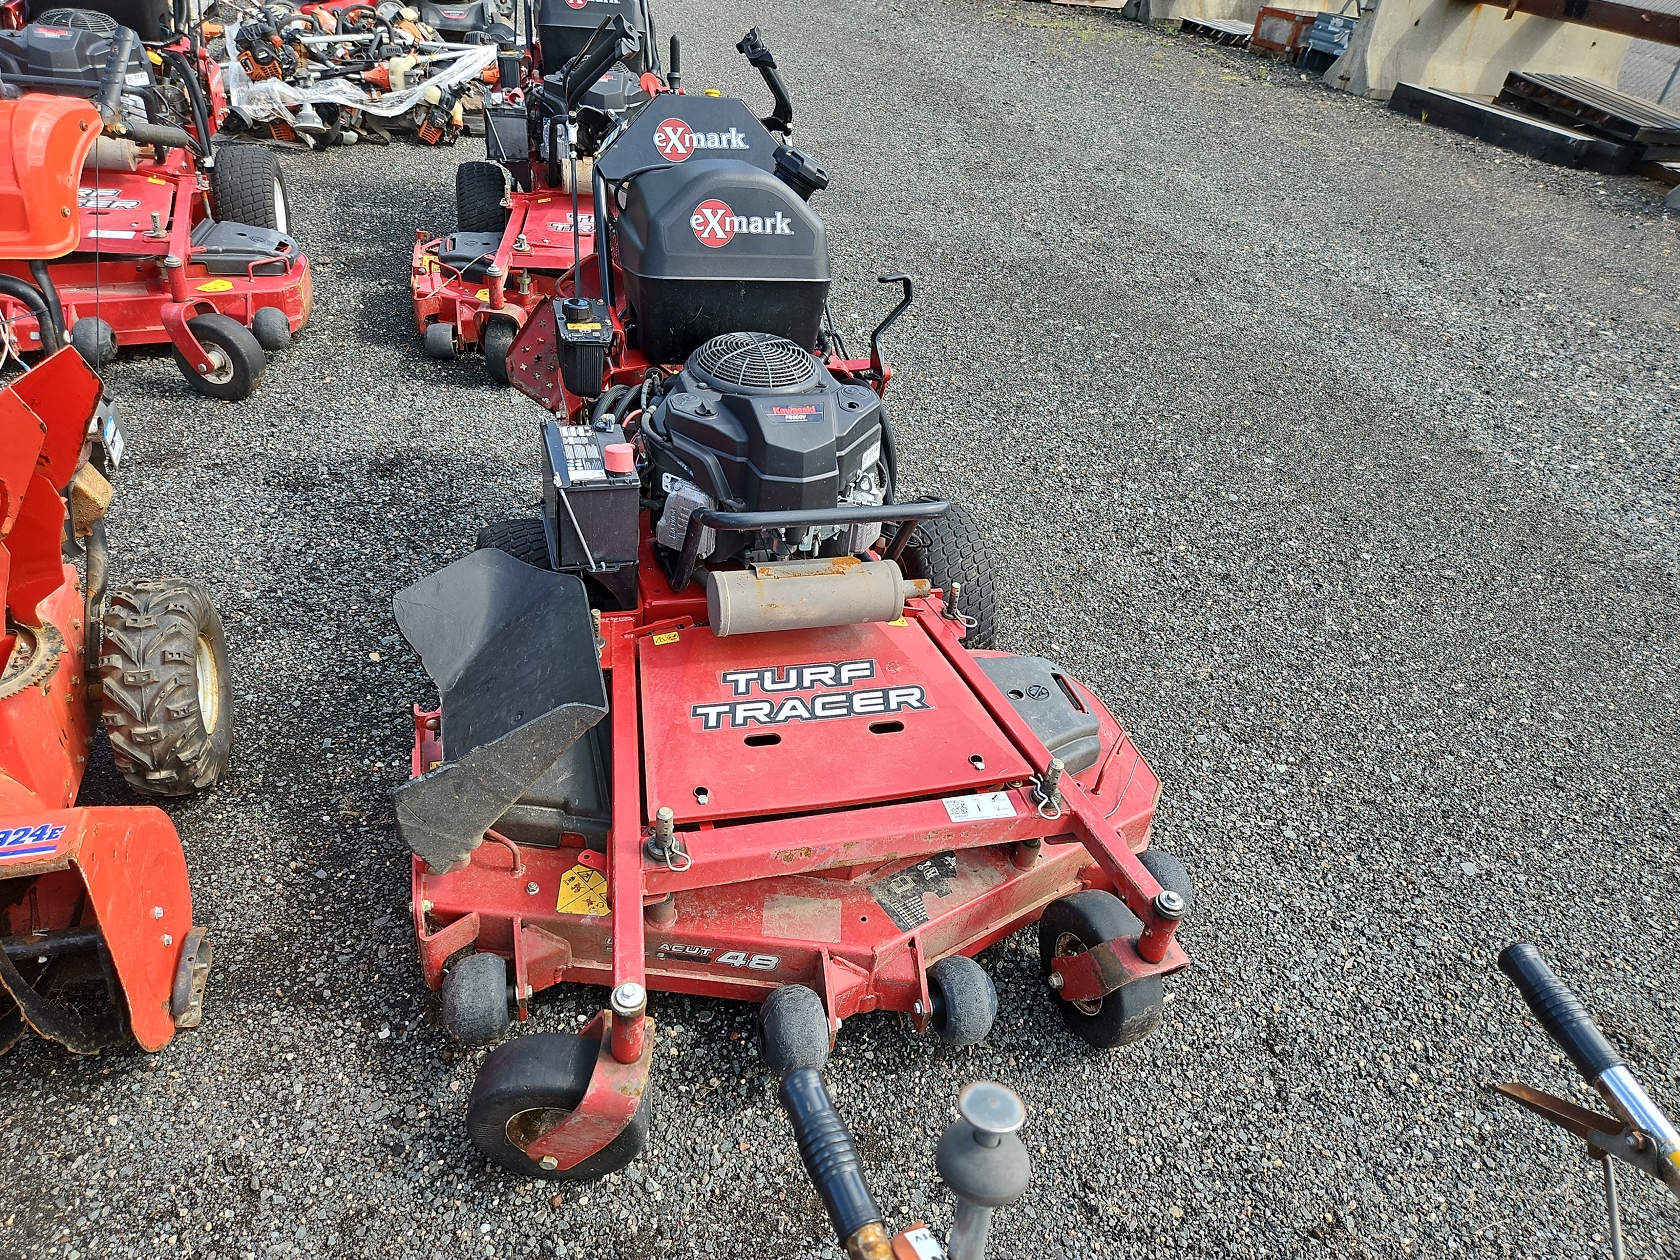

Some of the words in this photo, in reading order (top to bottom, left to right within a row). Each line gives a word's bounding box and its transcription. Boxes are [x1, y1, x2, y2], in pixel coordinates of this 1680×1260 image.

[653, 126, 748, 154] eXmark
[690, 208, 793, 239] eXmark
[772, 405, 817, 414] Kawasaki
[721, 659, 876, 696] TURF
[691, 684, 933, 730] TRACER
[715, 950, 782, 972] 48
